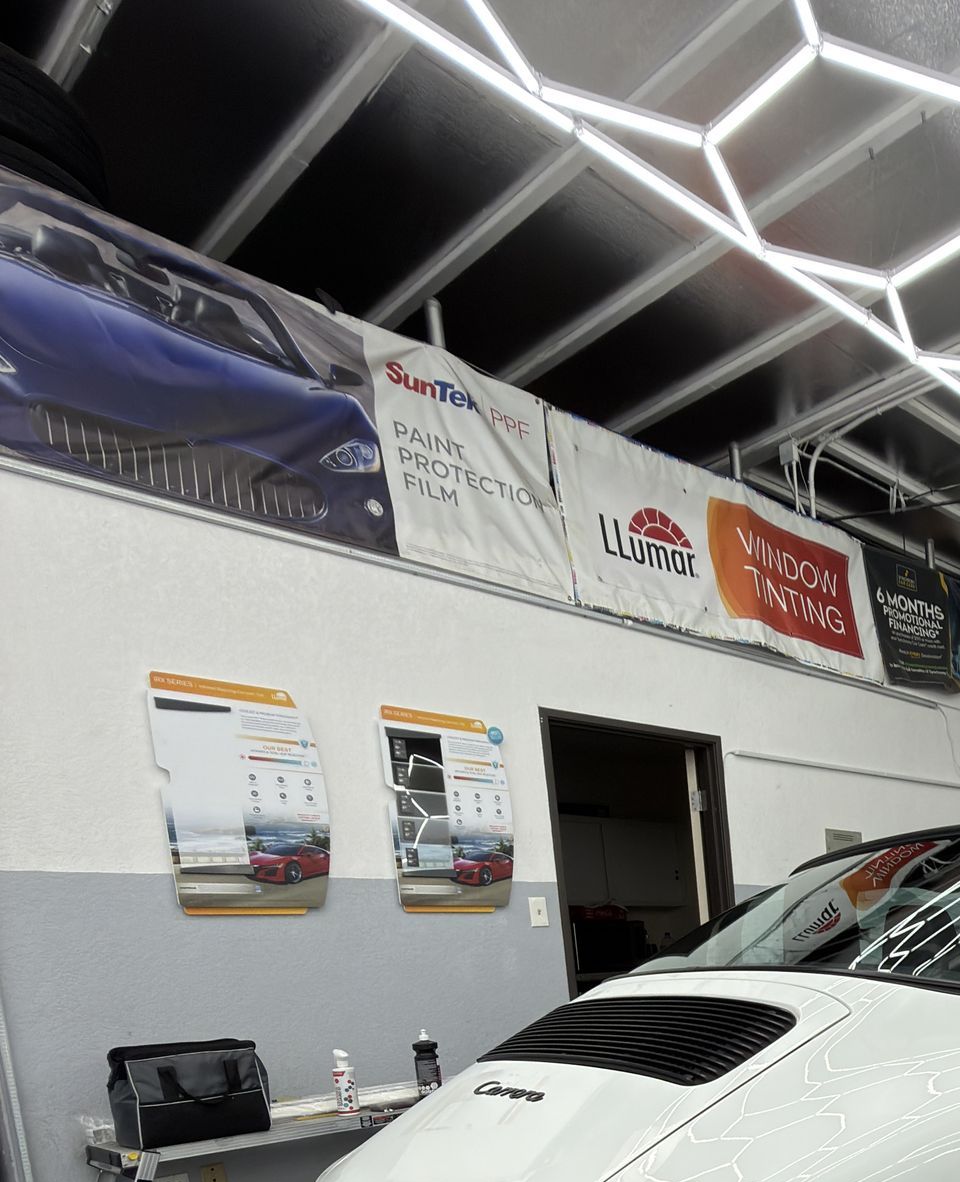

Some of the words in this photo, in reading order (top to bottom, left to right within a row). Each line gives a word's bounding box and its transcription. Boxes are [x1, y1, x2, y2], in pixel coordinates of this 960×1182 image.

[385, 361, 480, 414] SunTek
[490, 407, 529, 440] PPF
[393, 420, 464, 460] PAINT
[398, 446, 544, 513] PROTECTION
[403, 471, 459, 507] FILM
[598, 513, 696, 578] LLumar
[736, 527, 837, 597] WINDOW
[743, 565, 846, 635] TINTING
[876, 586, 885, 603] 6
[886, 590, 945, 620] MONTHS
[883, 605, 943, 630] PROMOTIONAL
[473, 1080, 546, 1103] Carrera
